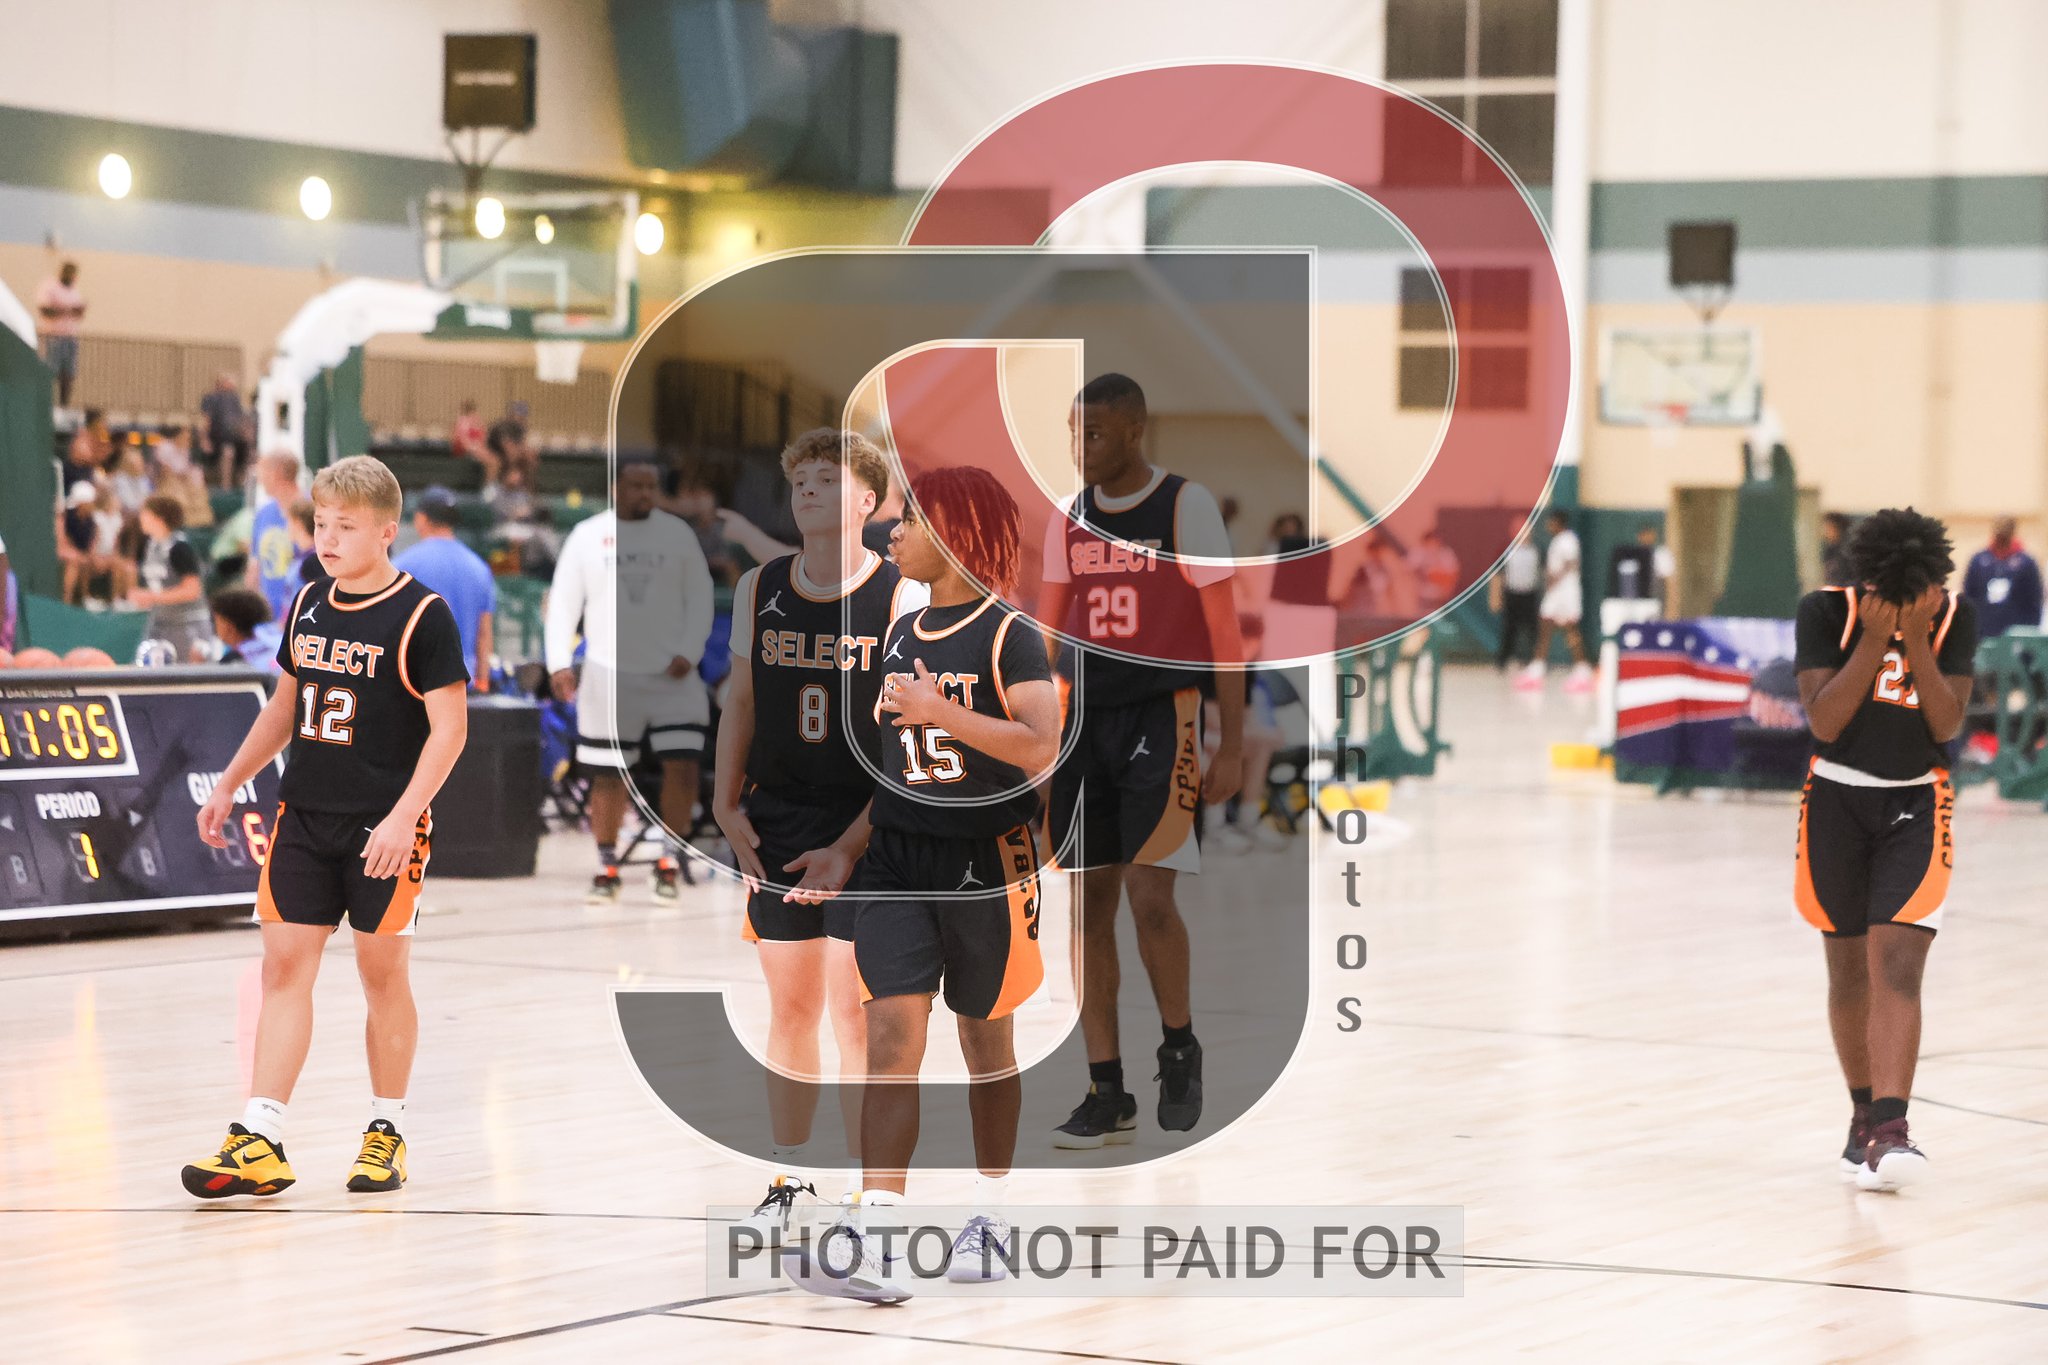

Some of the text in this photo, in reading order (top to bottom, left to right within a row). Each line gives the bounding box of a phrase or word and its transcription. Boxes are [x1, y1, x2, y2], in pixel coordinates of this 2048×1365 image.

[1070, 539, 1162, 575] SELECT
[1087, 586, 1139, 638] 29
[294, 633, 384, 678] SELECT
[761, 629, 878, 671] SELECT
[300, 682, 357, 745] 12
[799, 683, 829, 743] 8
[898, 725, 968, 786] 15
[34, 790, 101, 820] PERIOD
[242, 812, 270, 866] 6
